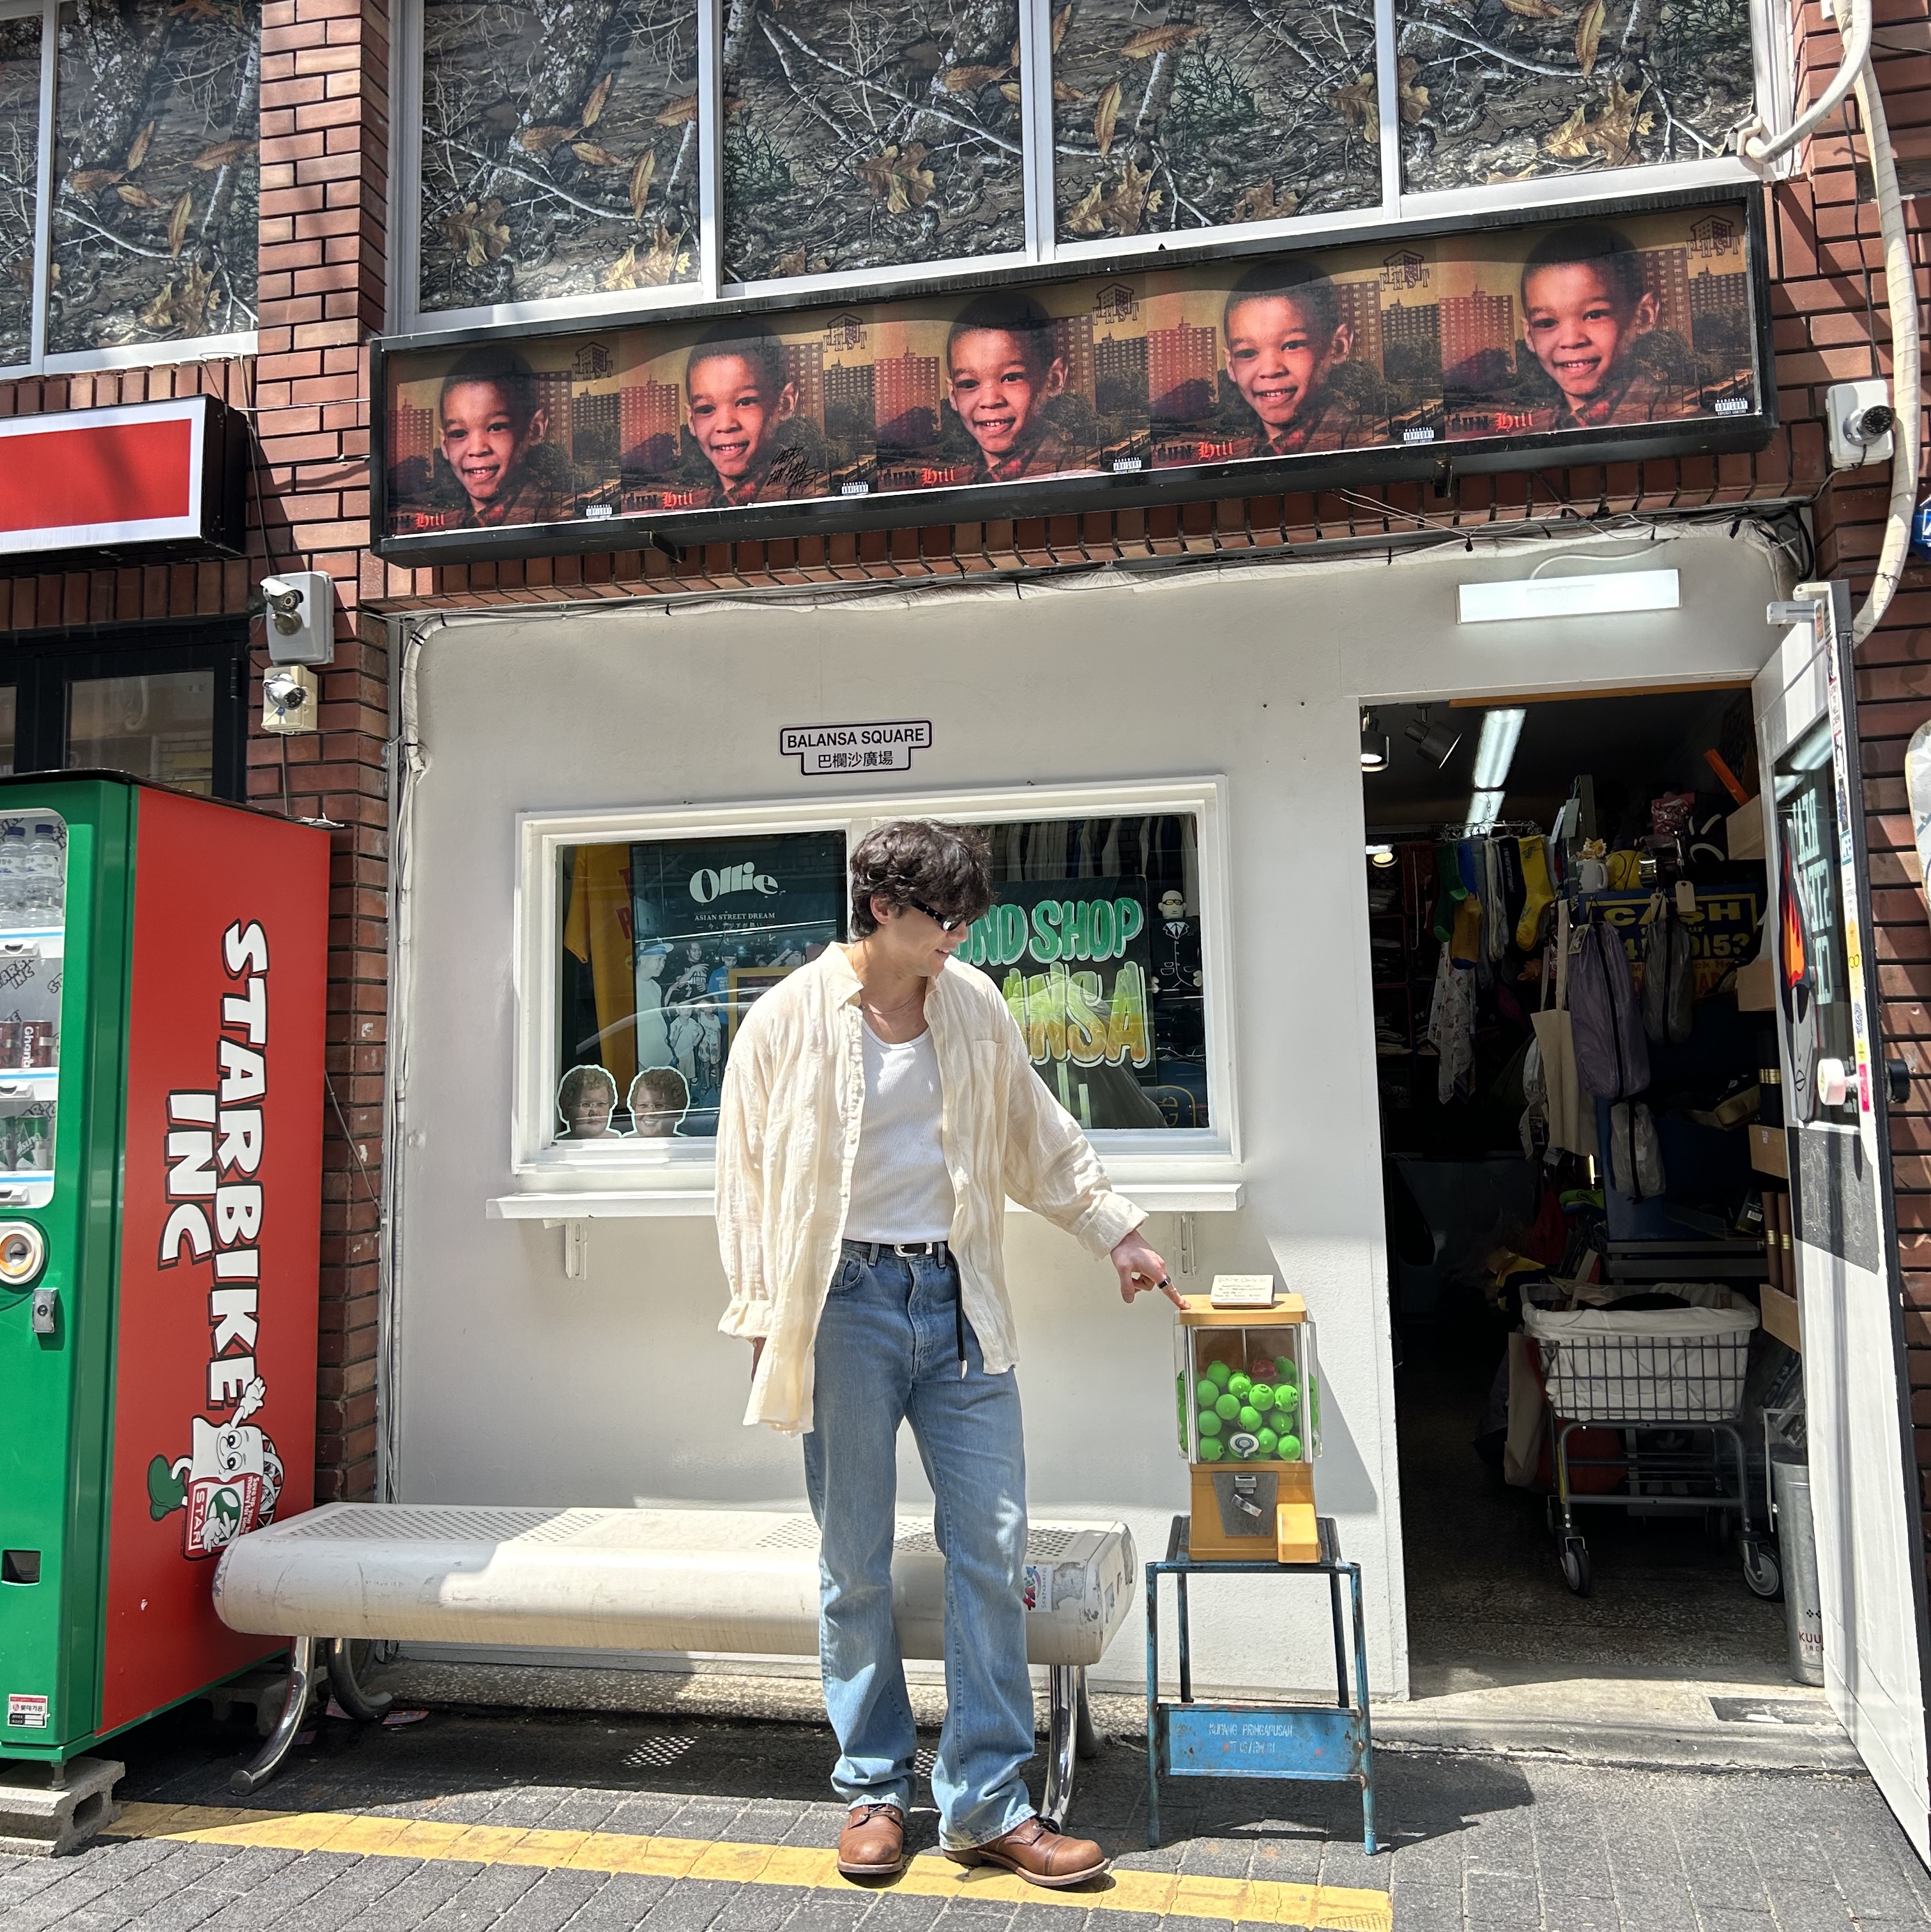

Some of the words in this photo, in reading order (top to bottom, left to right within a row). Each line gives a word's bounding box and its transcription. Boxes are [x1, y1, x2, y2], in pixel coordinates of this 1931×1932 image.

[1717, 402, 1746, 411] ADVISORY
[1495, 409, 1533, 432] Hill
[1405, 431, 1433, 440] ADVISORY
[1198, 439, 1234, 461] Hill
[921, 466, 954, 487] Hill
[662, 491, 693, 509] Hill
[415, 512, 445, 531] Hill
[788, 732, 857, 749] BALANSA
[862, 728, 924, 744] SQUARE
[818, 750, 894, 768] 巴欄沙廣場
[689, 862, 779, 903] Ollie
[1029, 897, 1143, 964] SHOP
[10, 965, 35, 989] INC
[208, 920, 270, 1409] STARBIKE
[158, 1090, 218, 1269] INC
[244, 1475, 253, 1503] money
[192, 1490, 205, 1544] STAR
